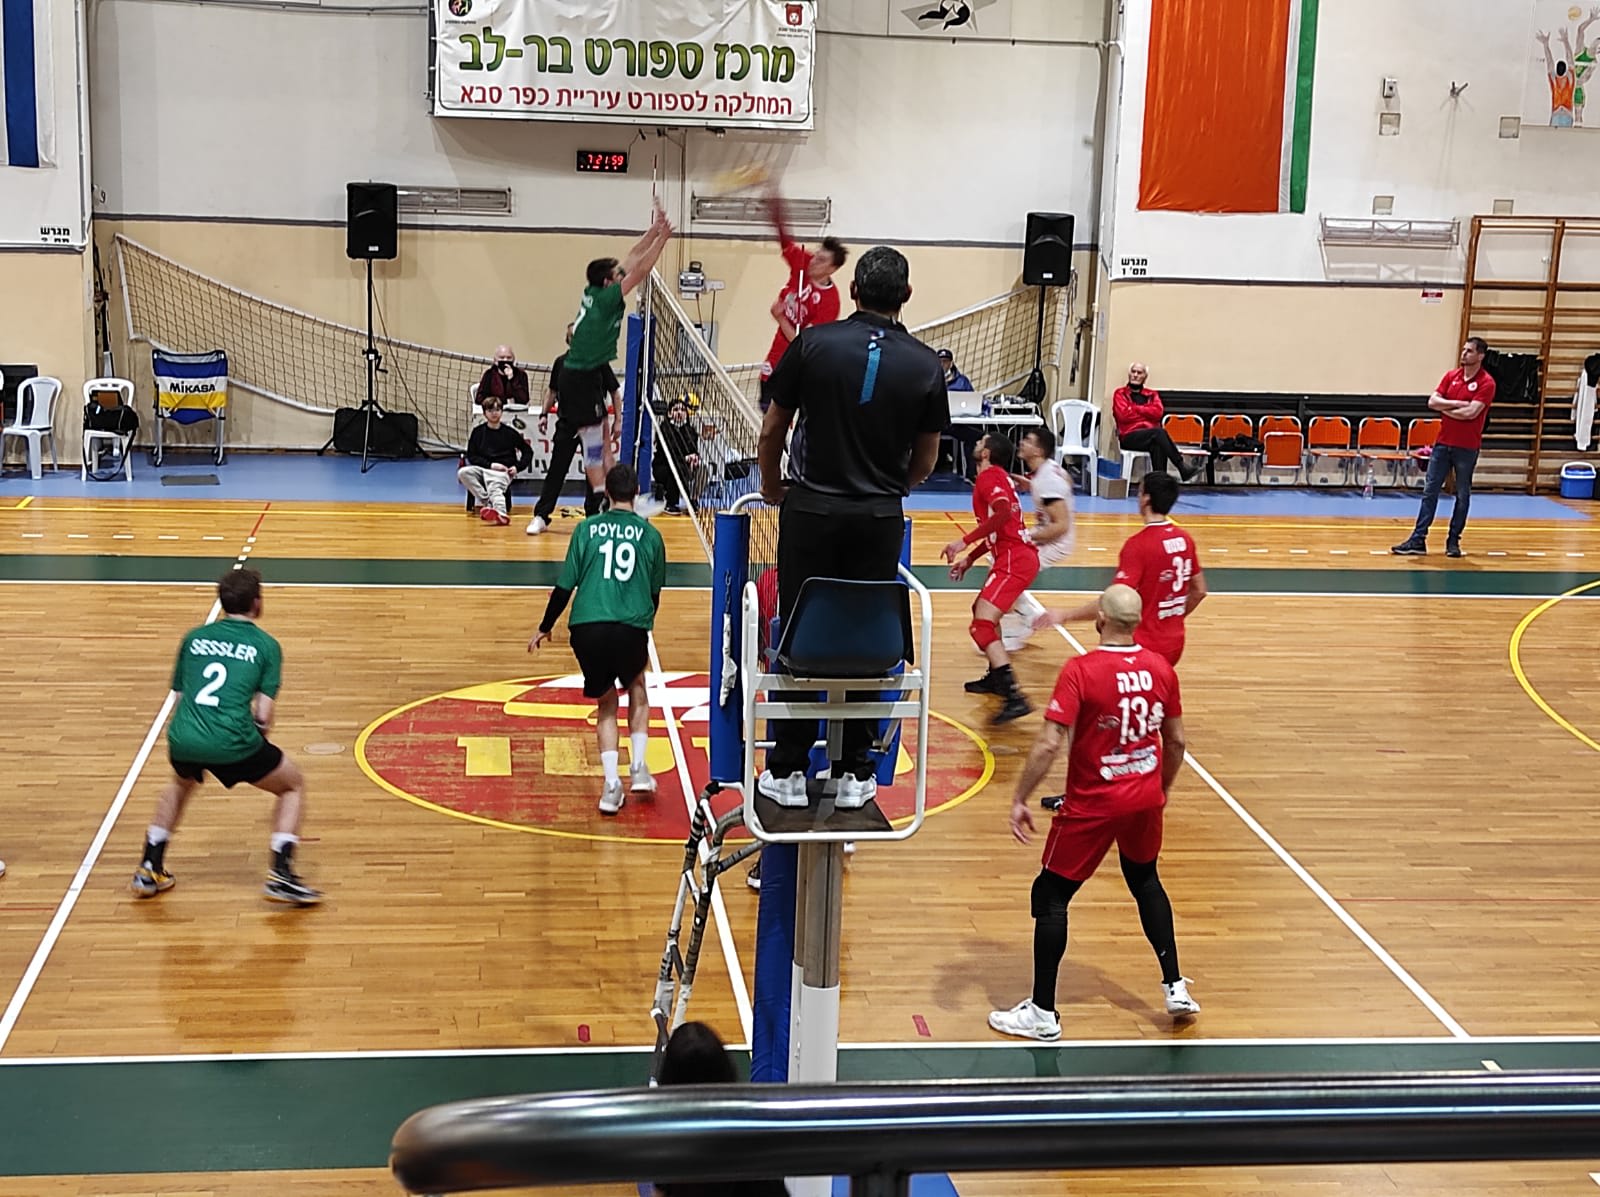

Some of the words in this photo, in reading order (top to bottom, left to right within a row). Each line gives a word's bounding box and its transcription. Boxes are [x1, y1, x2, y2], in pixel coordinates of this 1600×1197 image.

[459, 26, 574, 73] בר-לב
[584, 38, 704, 80] ספורט
[714, 43, 796, 83] מרכז
[460, 85, 503, 104] סבא
[508, 86, 550, 106] כפר
[555, 88, 621, 110] עיריית
[627, 90, 708, 112] לספורט
[714, 92, 792, 116] המחלקה
[1121, 258, 1148, 266] מגרש
[589, 522, 644, 541] POYLOV
[599, 538, 636, 582] 19
[194, 661, 227, 707] 2
[1116, 669, 1153, 694] סבה
[1118, 695, 1148, 745] 13
